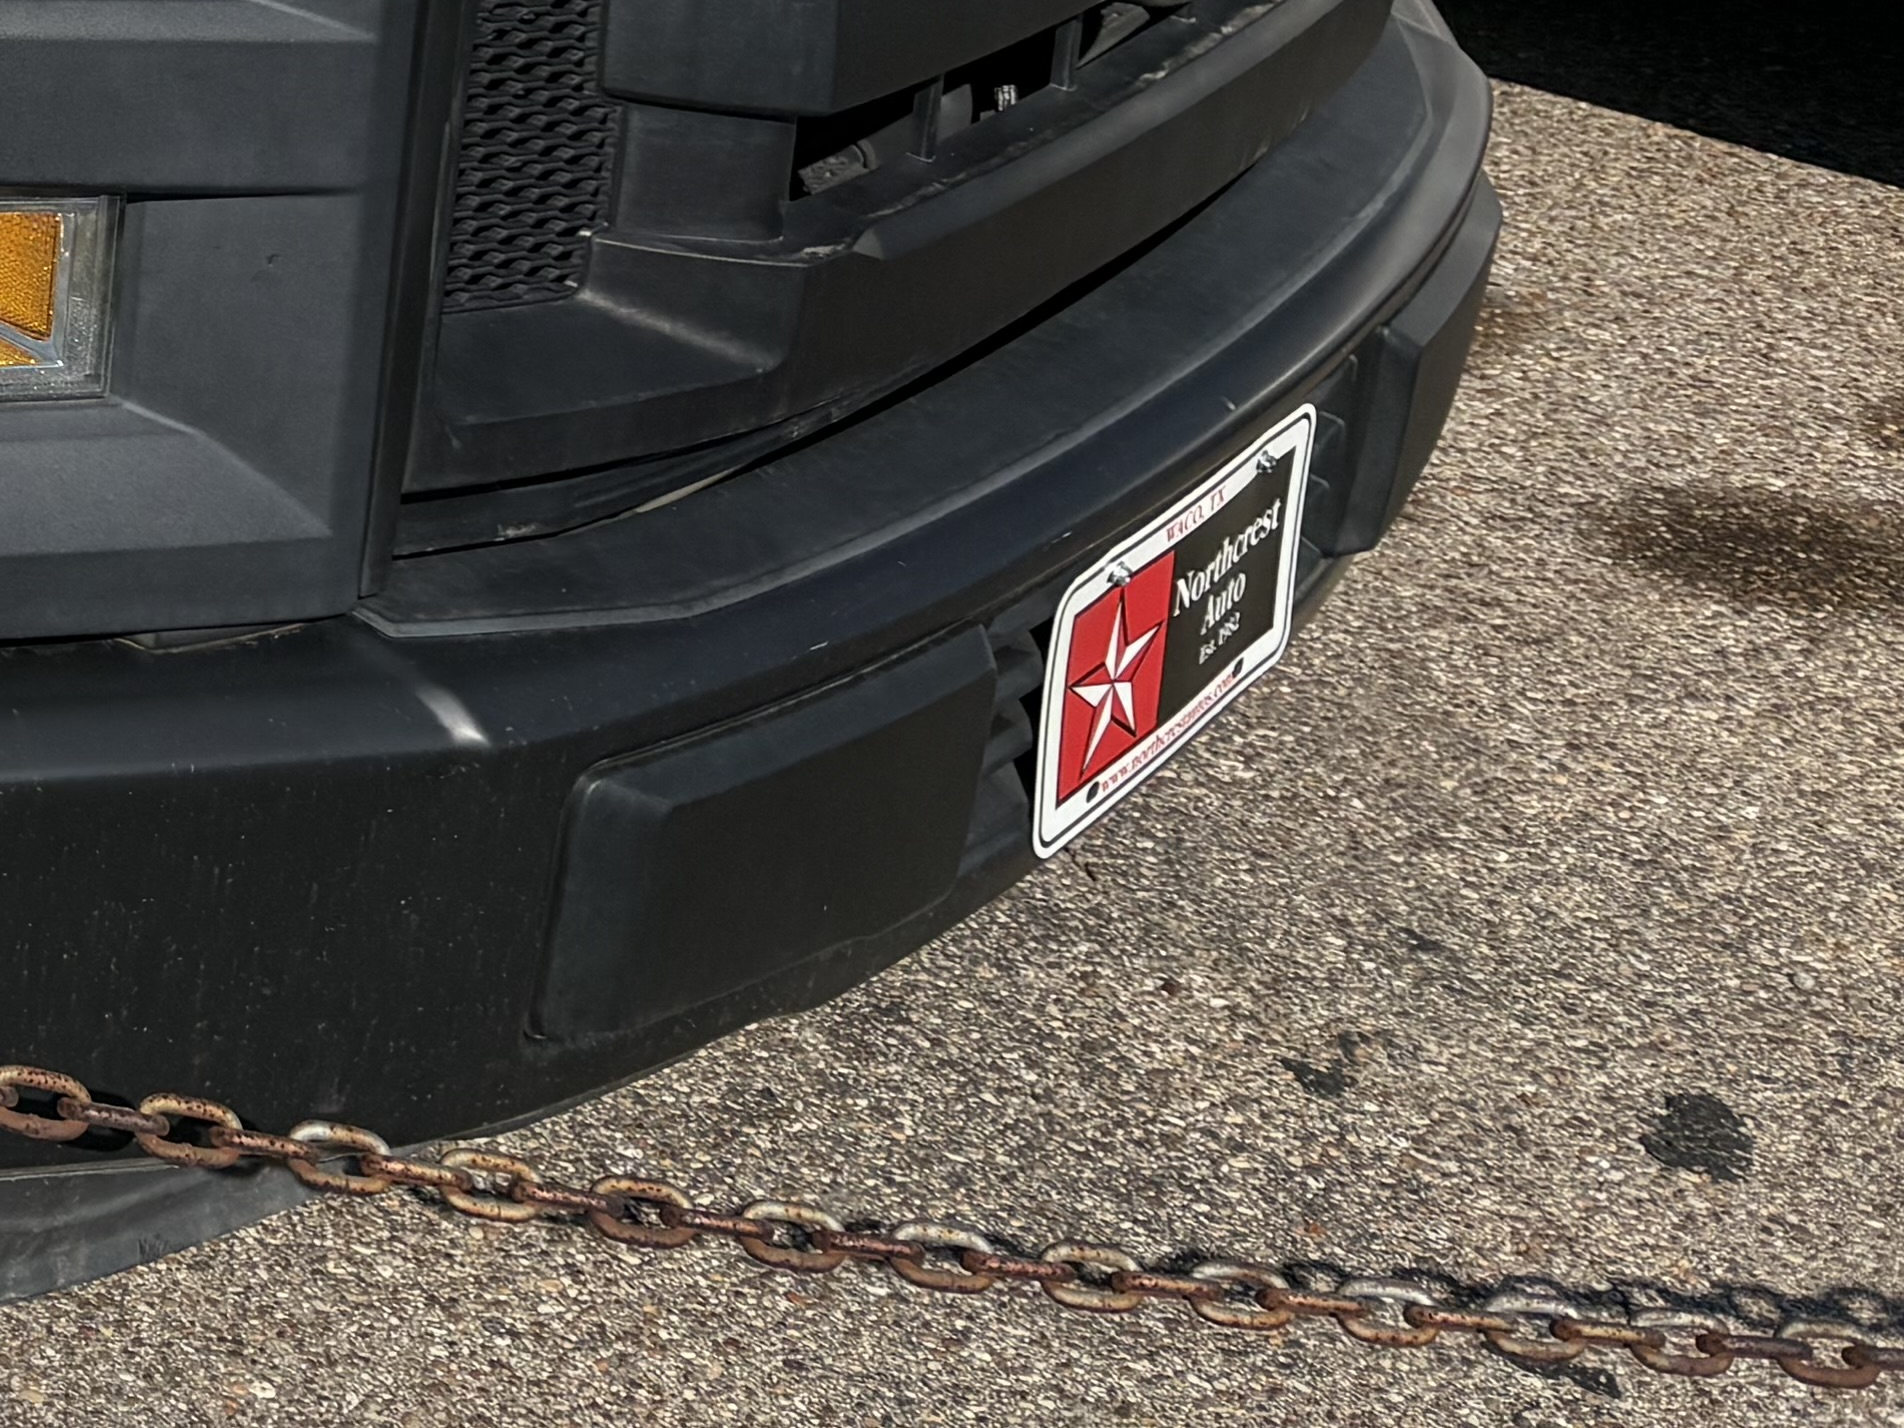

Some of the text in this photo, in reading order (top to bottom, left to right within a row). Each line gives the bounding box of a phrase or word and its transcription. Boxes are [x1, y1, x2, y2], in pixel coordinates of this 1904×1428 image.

[1210, 485, 1228, 512] TX
[1173, 497, 1282, 617] Northcrest
[1200, 572, 1247, 635] Auto
